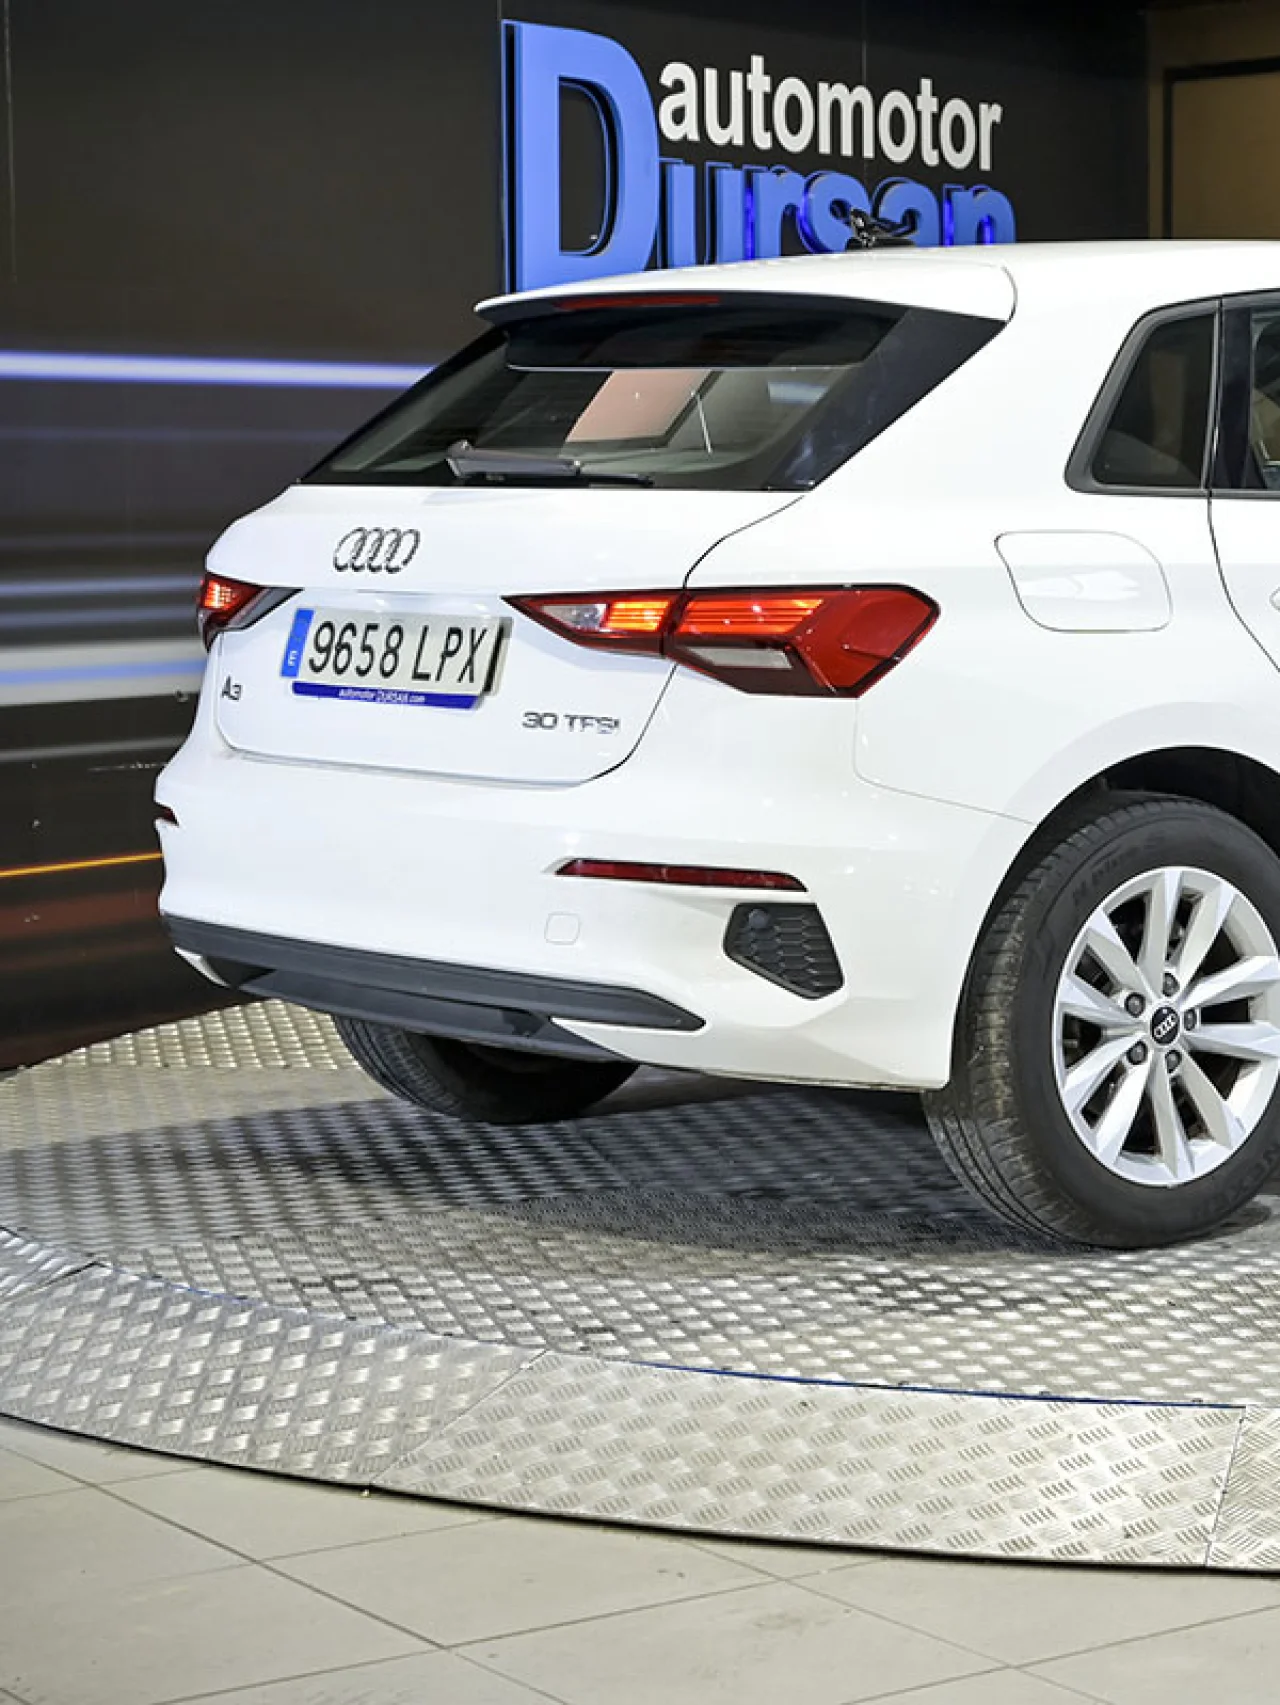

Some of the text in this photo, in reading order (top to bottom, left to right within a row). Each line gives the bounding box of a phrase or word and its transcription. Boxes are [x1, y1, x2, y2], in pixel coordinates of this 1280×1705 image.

[658, 54, 1002, 171] automotor
[309, 620, 488, 684] 9658 LPX
[221, 675, 242, 701] A3
[522, 711, 558, 730] 30
